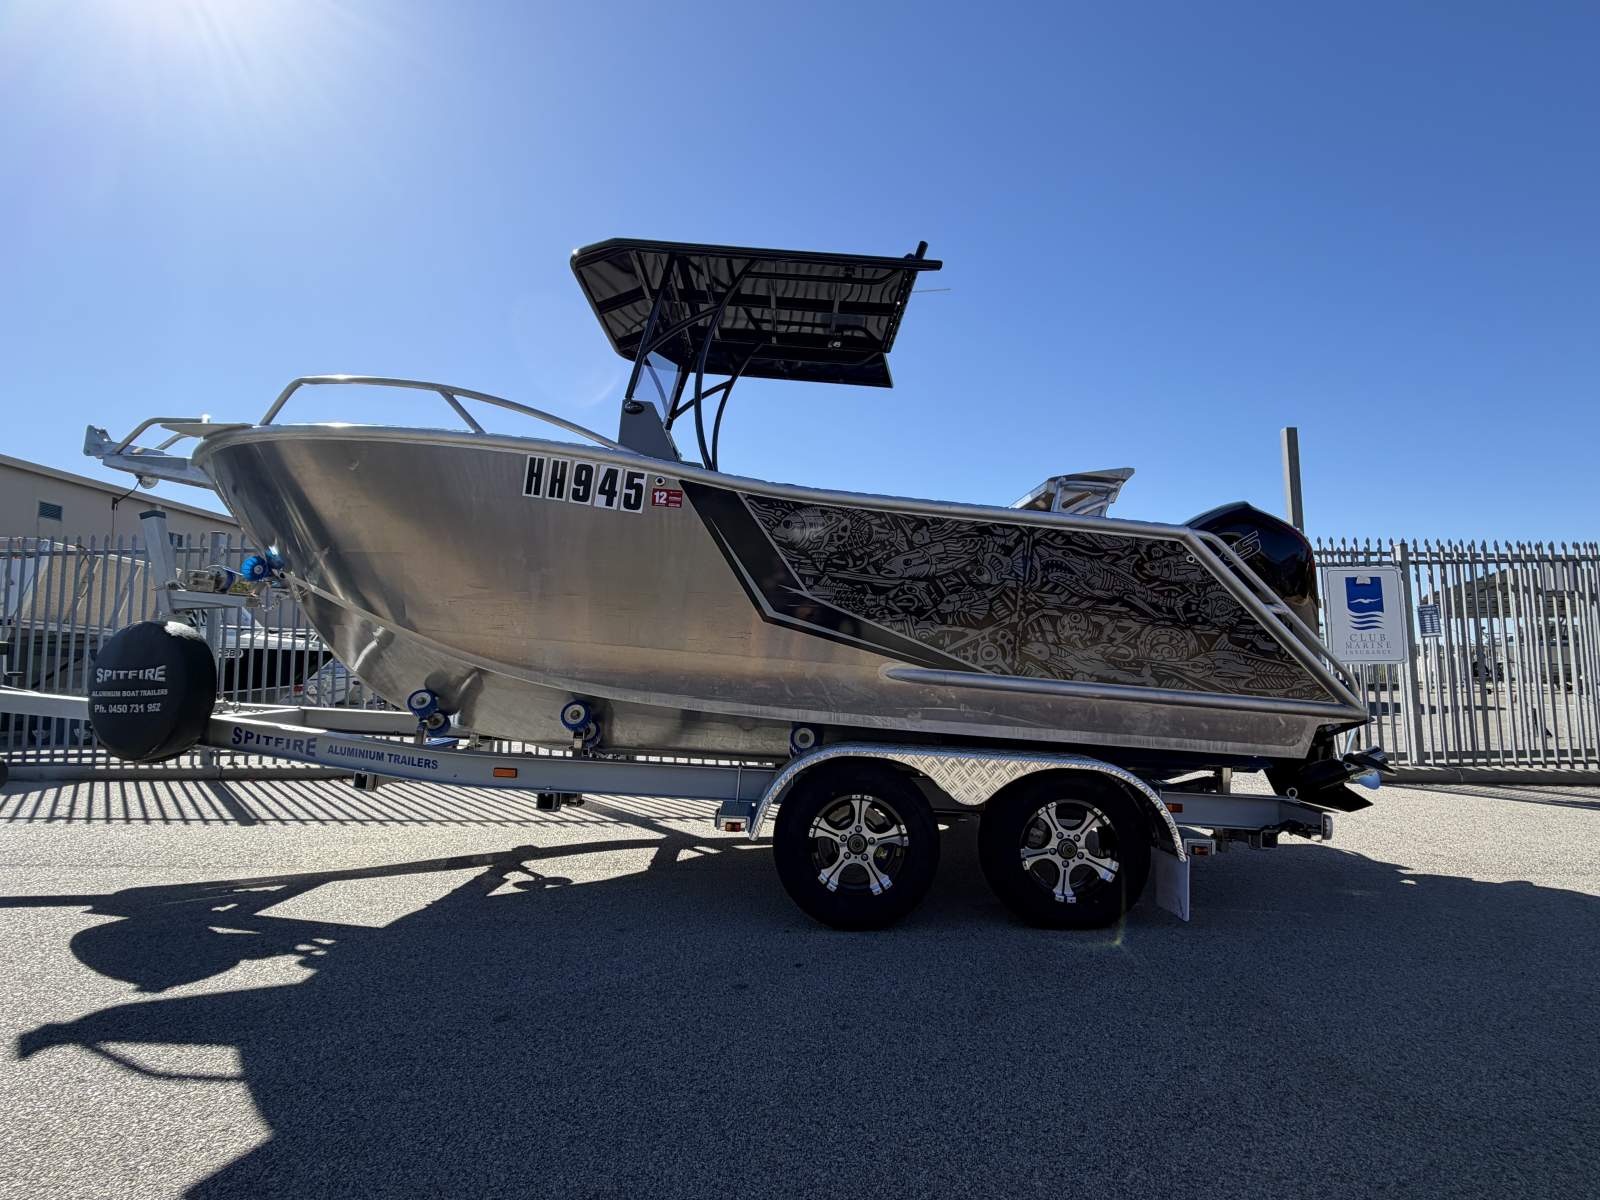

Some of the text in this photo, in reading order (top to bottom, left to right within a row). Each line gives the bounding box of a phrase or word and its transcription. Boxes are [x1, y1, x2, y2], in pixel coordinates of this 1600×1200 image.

[524, 456, 646, 511] HH945
[653, 491, 668, 504] 12
[1349, 633, 1387, 642] CLUB
[1345, 641, 1392, 649] MARINE
[95, 664, 168, 683] SPITFIRE
[140, 688, 169, 697] TRAILERS
[94, 703, 107, 713] Ph.
[108, 703, 128, 713] 0450
[129, 703, 144, 713] 731
[231, 726, 440, 770] SPITFIRE ALUMINIUM TRAILERS
